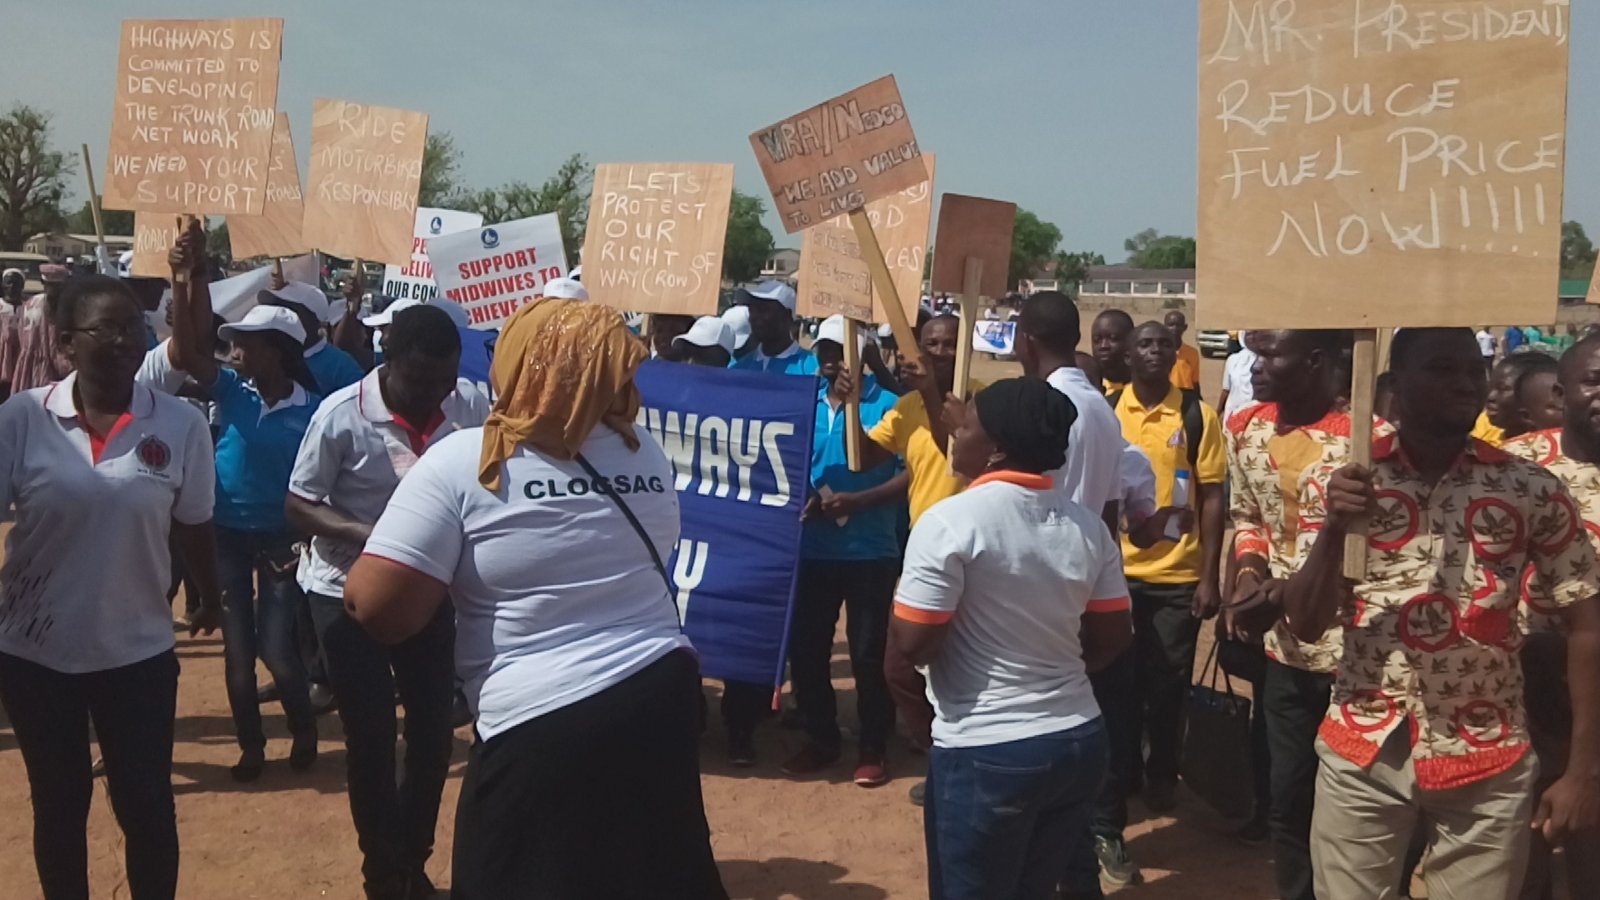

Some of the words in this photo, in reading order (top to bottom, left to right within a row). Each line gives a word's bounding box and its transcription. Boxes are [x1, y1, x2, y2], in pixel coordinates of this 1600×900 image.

[131, 25, 235, 50] HIGHWAYS
[249, 30, 272, 50] IS
[128, 54, 225, 75] COMMITTED
[236, 57, 260, 73] TO
[128, 75, 254, 101] DEVELOPING
[125, 102, 158, 121] THE
[170, 104, 232, 131] TRUNK
[1216, 79, 1460, 136] REDUCE
[132, 125, 173, 144] NET
[183, 128, 239, 149] WORK
[338, 103, 406, 144] RIDE
[114, 153, 142, 177] WE
[145, 153, 187, 174] NEED
[199, 155, 258, 181] YOUR
[1221, 135, 1360, 199] FUEL
[1387, 126, 1564, 191] PRICE
[819, 166, 859, 196] ADD
[137, 180, 257, 212] SUPPORT
[602, 192, 707, 221] PROTECT
[605, 219, 676, 243] OUR
[458, 247, 537, 280] SUPPORT
[601, 241, 680, 266] RIGHT
[692, 251, 717, 274] OF
[386, 280, 409, 299] OUR
[412, 283, 440, 302] CON
[446, 271, 536, 304] MIDWIVES
[465, 299, 519, 325] HIEVE
[635, 406, 794, 507] WAYS
[523, 474, 665, 500] CLOGSAG
